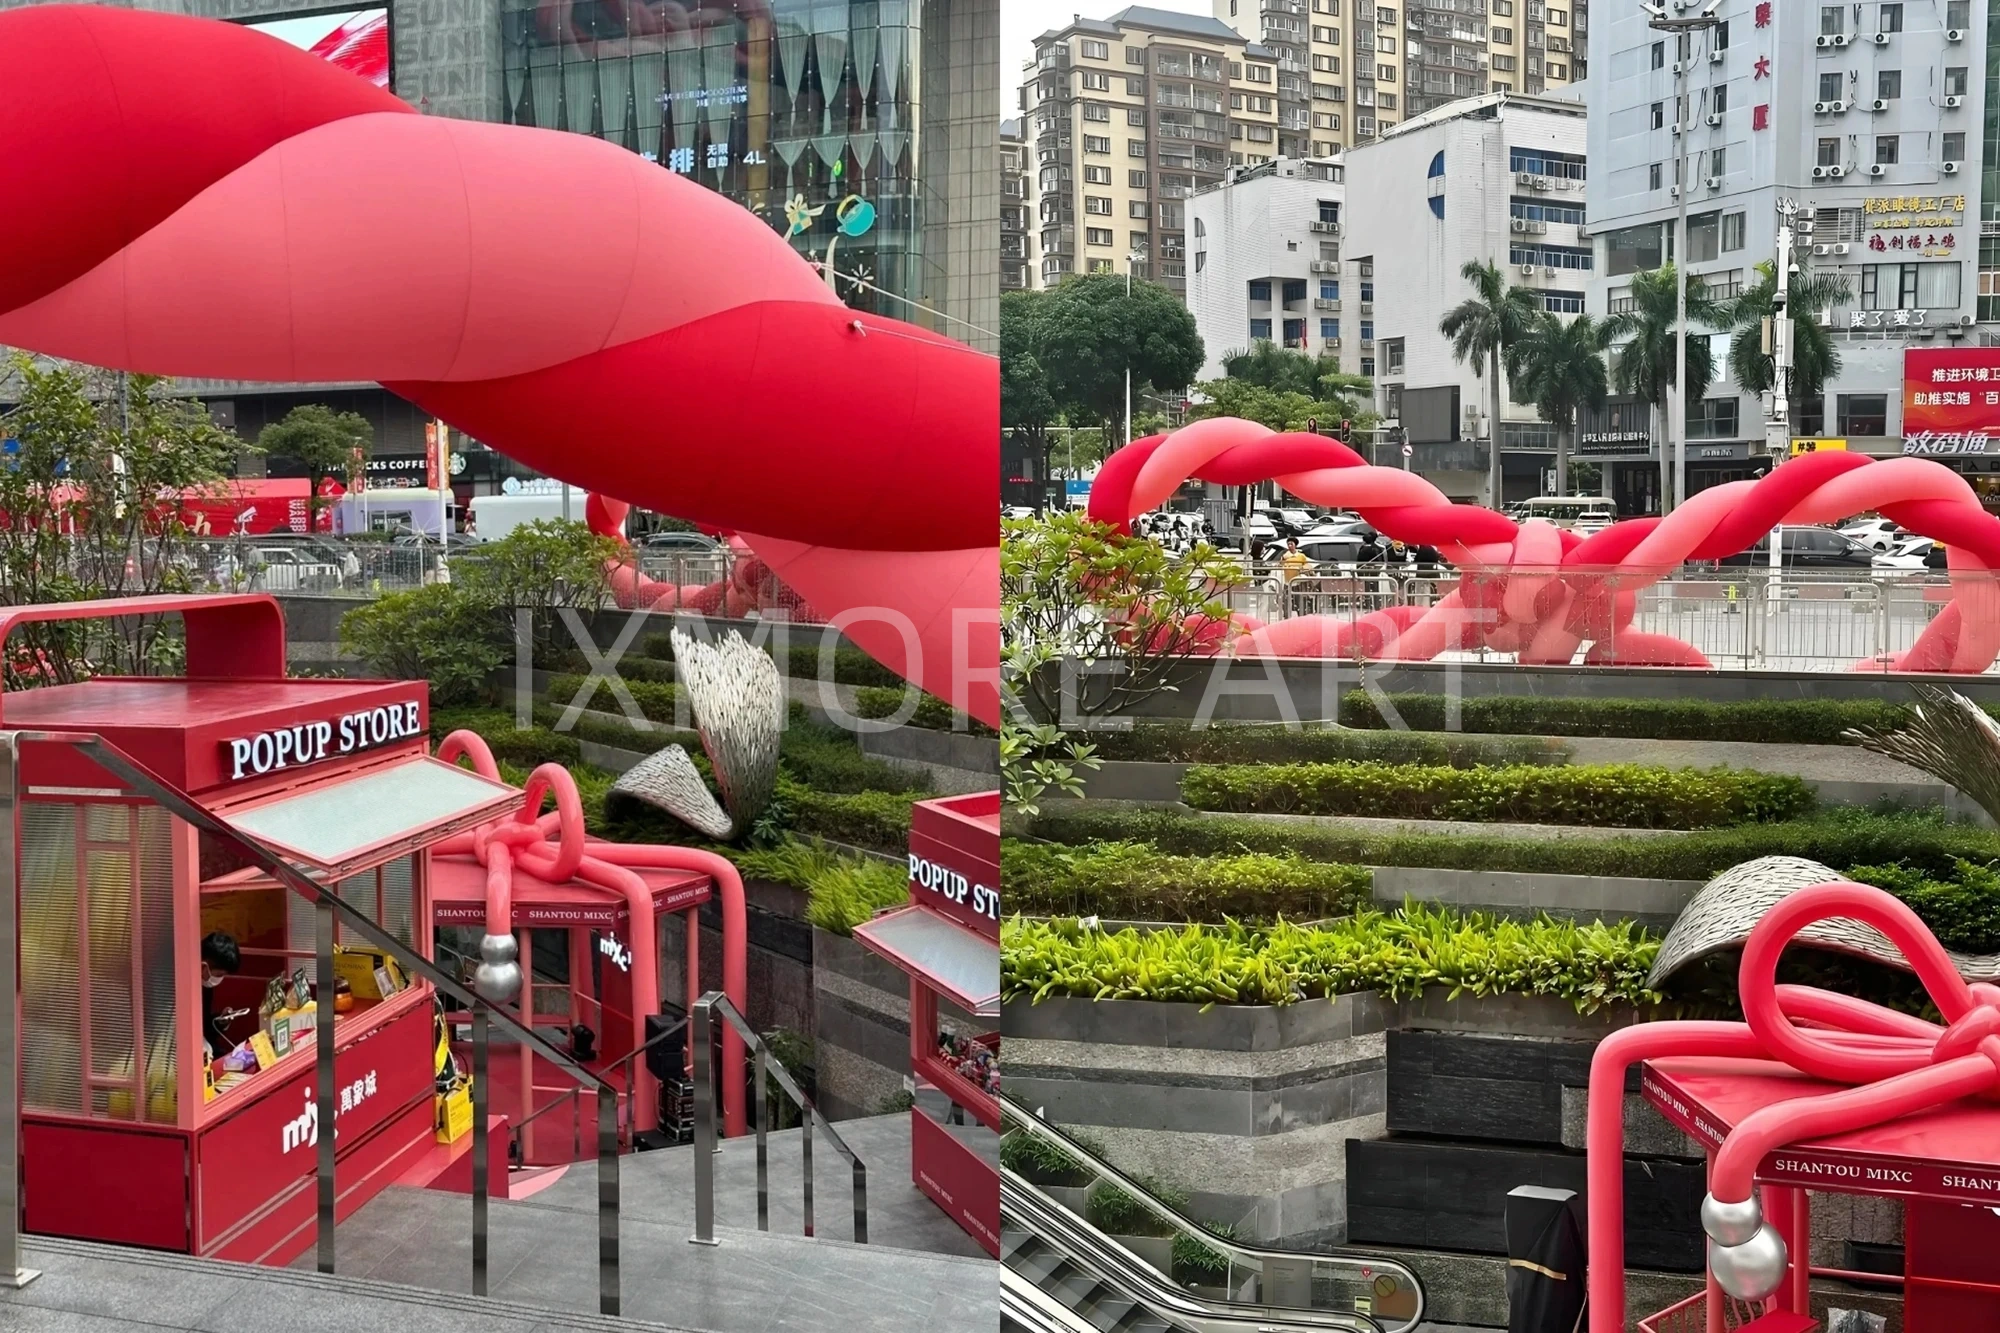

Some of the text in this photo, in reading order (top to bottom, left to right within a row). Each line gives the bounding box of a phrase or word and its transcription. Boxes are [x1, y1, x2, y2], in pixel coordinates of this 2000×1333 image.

[706, 143, 729, 156] 无限
[707, 157, 729, 169] 自助
[742, 151, 766, 166] 4L
[388, 459, 428, 470] COFFE
[231, 701, 421, 780] POPUP STORE
[908, 853, 1000, 921] POPUP ST
[667, 889, 694, 904] SHANTOU
[529, 911, 581, 919] SHANTOU
[583, 911, 612, 920] MIXC
[1775, 1159, 1913, 1183] SHANTOU MIXC
